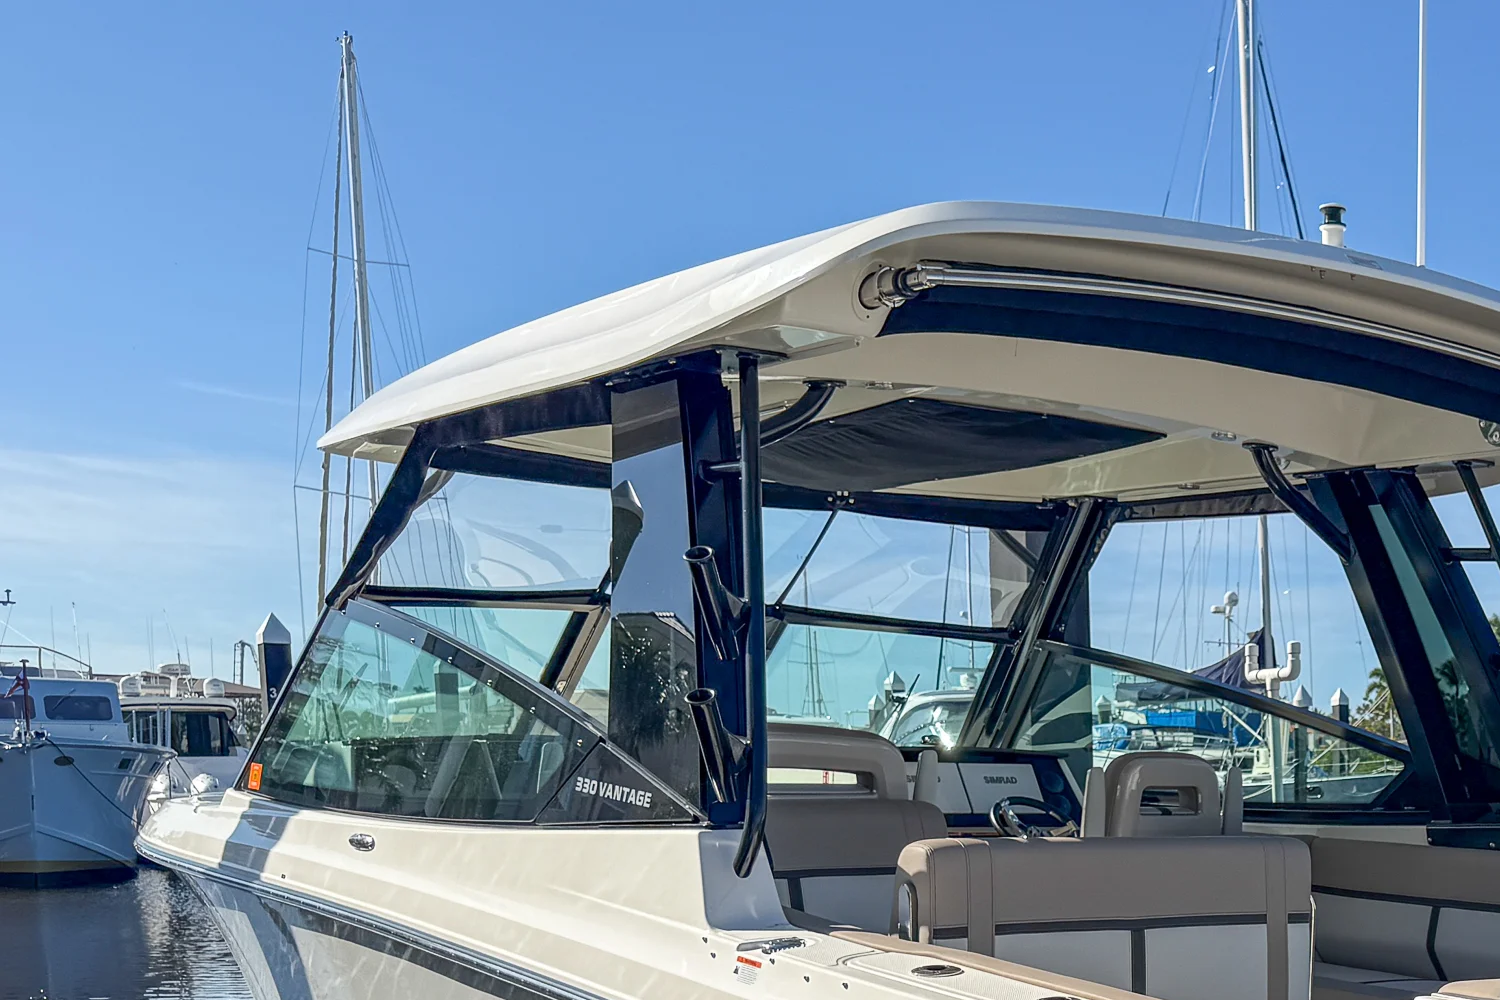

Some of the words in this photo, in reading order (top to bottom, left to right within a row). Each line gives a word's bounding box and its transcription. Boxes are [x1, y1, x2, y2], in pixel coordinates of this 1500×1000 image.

[269, 687, 278, 698] 3
[983, 775, 1018, 785] SIMRAD
[575, 776, 598, 795] 330
[599, 781, 652, 808] VANTAGE
